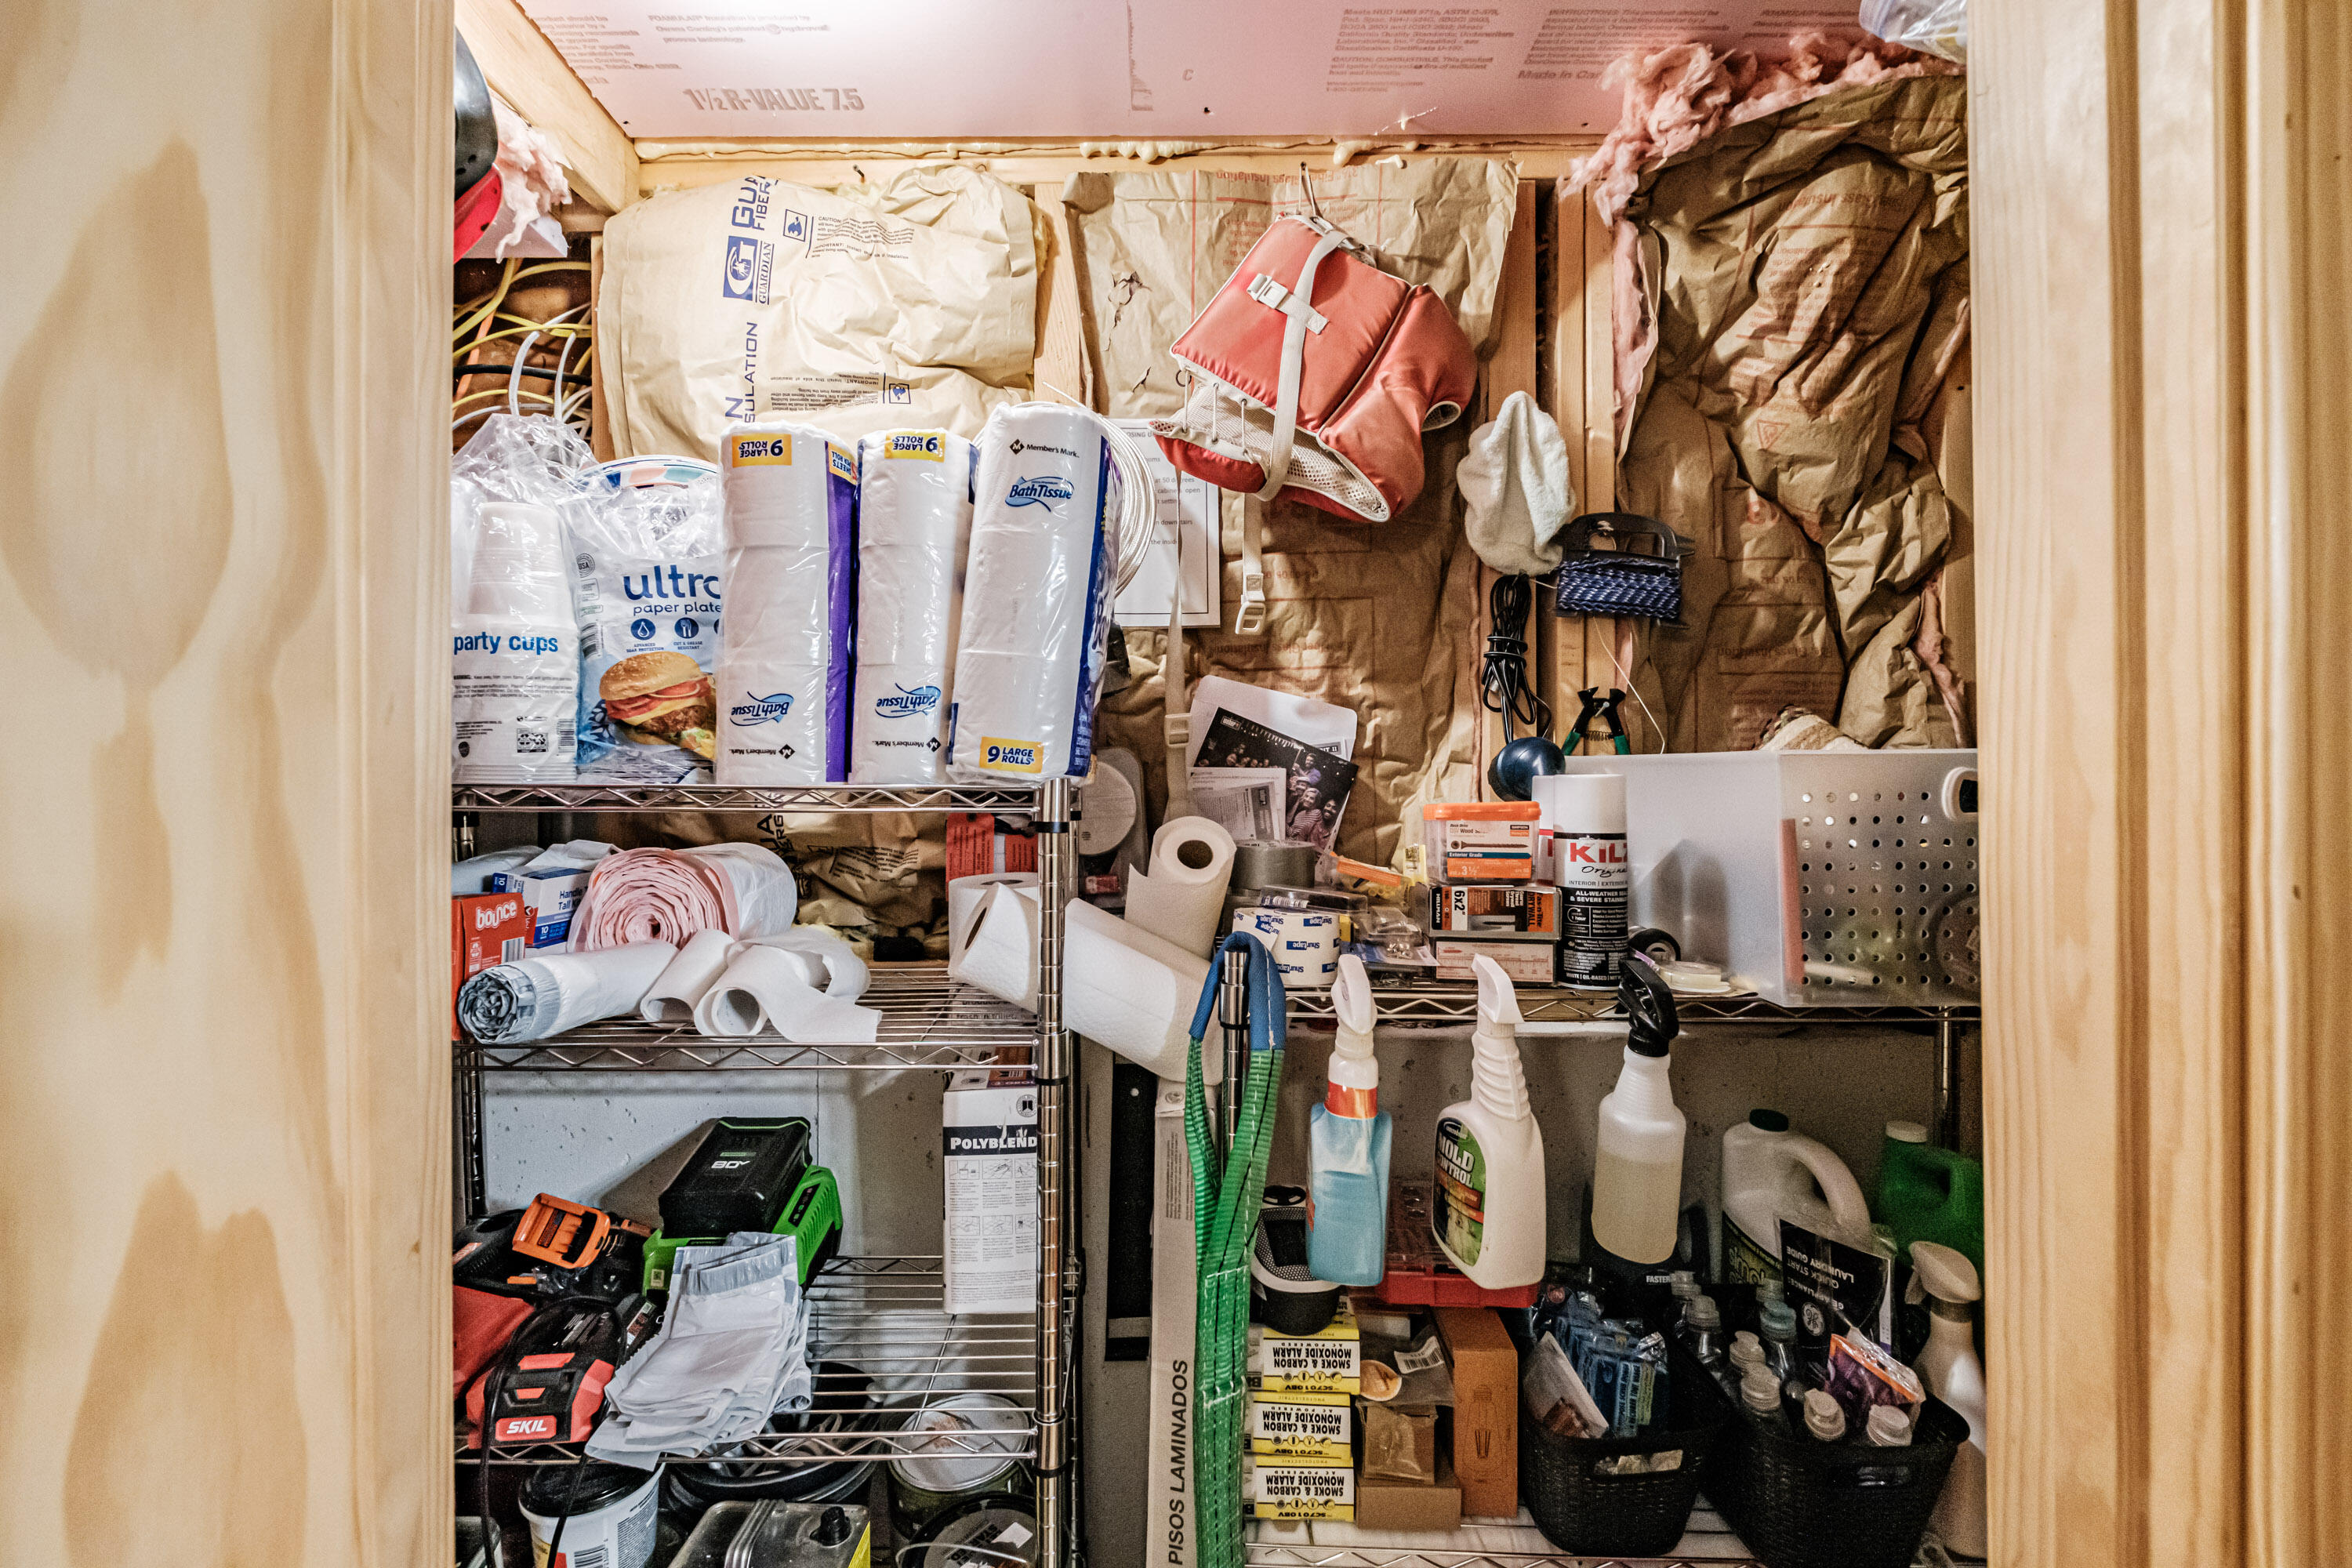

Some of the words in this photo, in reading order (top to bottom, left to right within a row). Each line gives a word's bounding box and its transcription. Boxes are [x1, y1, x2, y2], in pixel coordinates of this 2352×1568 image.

[720, 88, 826, 111] R-VALUE
[821, 88, 866, 111] 7.5
[758, 241, 772, 305] GUARDIAN
[893, 443, 924, 452] LARGE
[1026, 444, 1059, 454] Member's
[739, 448, 768, 459] LARGE
[633, 603, 681, 616] paper
[454, 631, 501, 655] party
[508, 633, 558, 655] cups
[987, 746, 1000, 764] 9
[1003, 746, 1034, 757] LARGE
[476, 901, 517, 930] bounce
[541, 926, 549, 935] 10
[949, 1136, 1038, 1150] POLYBLEND
[1809, 1257, 1854, 1283] LAUNDRY
[1646, 1274, 1671, 1283] FASTER
[1272, 1348, 1302, 1358] ALARM
[1305, 1348, 1352, 1359] MONOXIDE
[1273, 1359, 1308, 1369] CARBON
[1311, 1359, 1318, 1368] &
[1320, 1359, 1351, 1369] SMOKE
[1262, 1410, 1292, 1422] ALARM
[1294, 1413, 1342, 1425] MONOXIDE
[506, 1419, 547, 1434] SKIL
[1170, 1359, 1188, 1493] LAMINADOS
[1264, 1421, 1298, 1432] CARBON
[1301, 1424, 1308, 1433] &
[1310, 1425, 1341, 1436] SMOKE
[1265, 1475, 1296, 1486] ALARM
[1298, 1475, 1345, 1486] MONOXIDE
[1267, 1486, 1301, 1496] CARBON
[1304, 1486, 1311, 1496] &
[1313, 1486, 1345, 1497] SMOKE
[1169, 1499, 1185, 1565] PISOS
